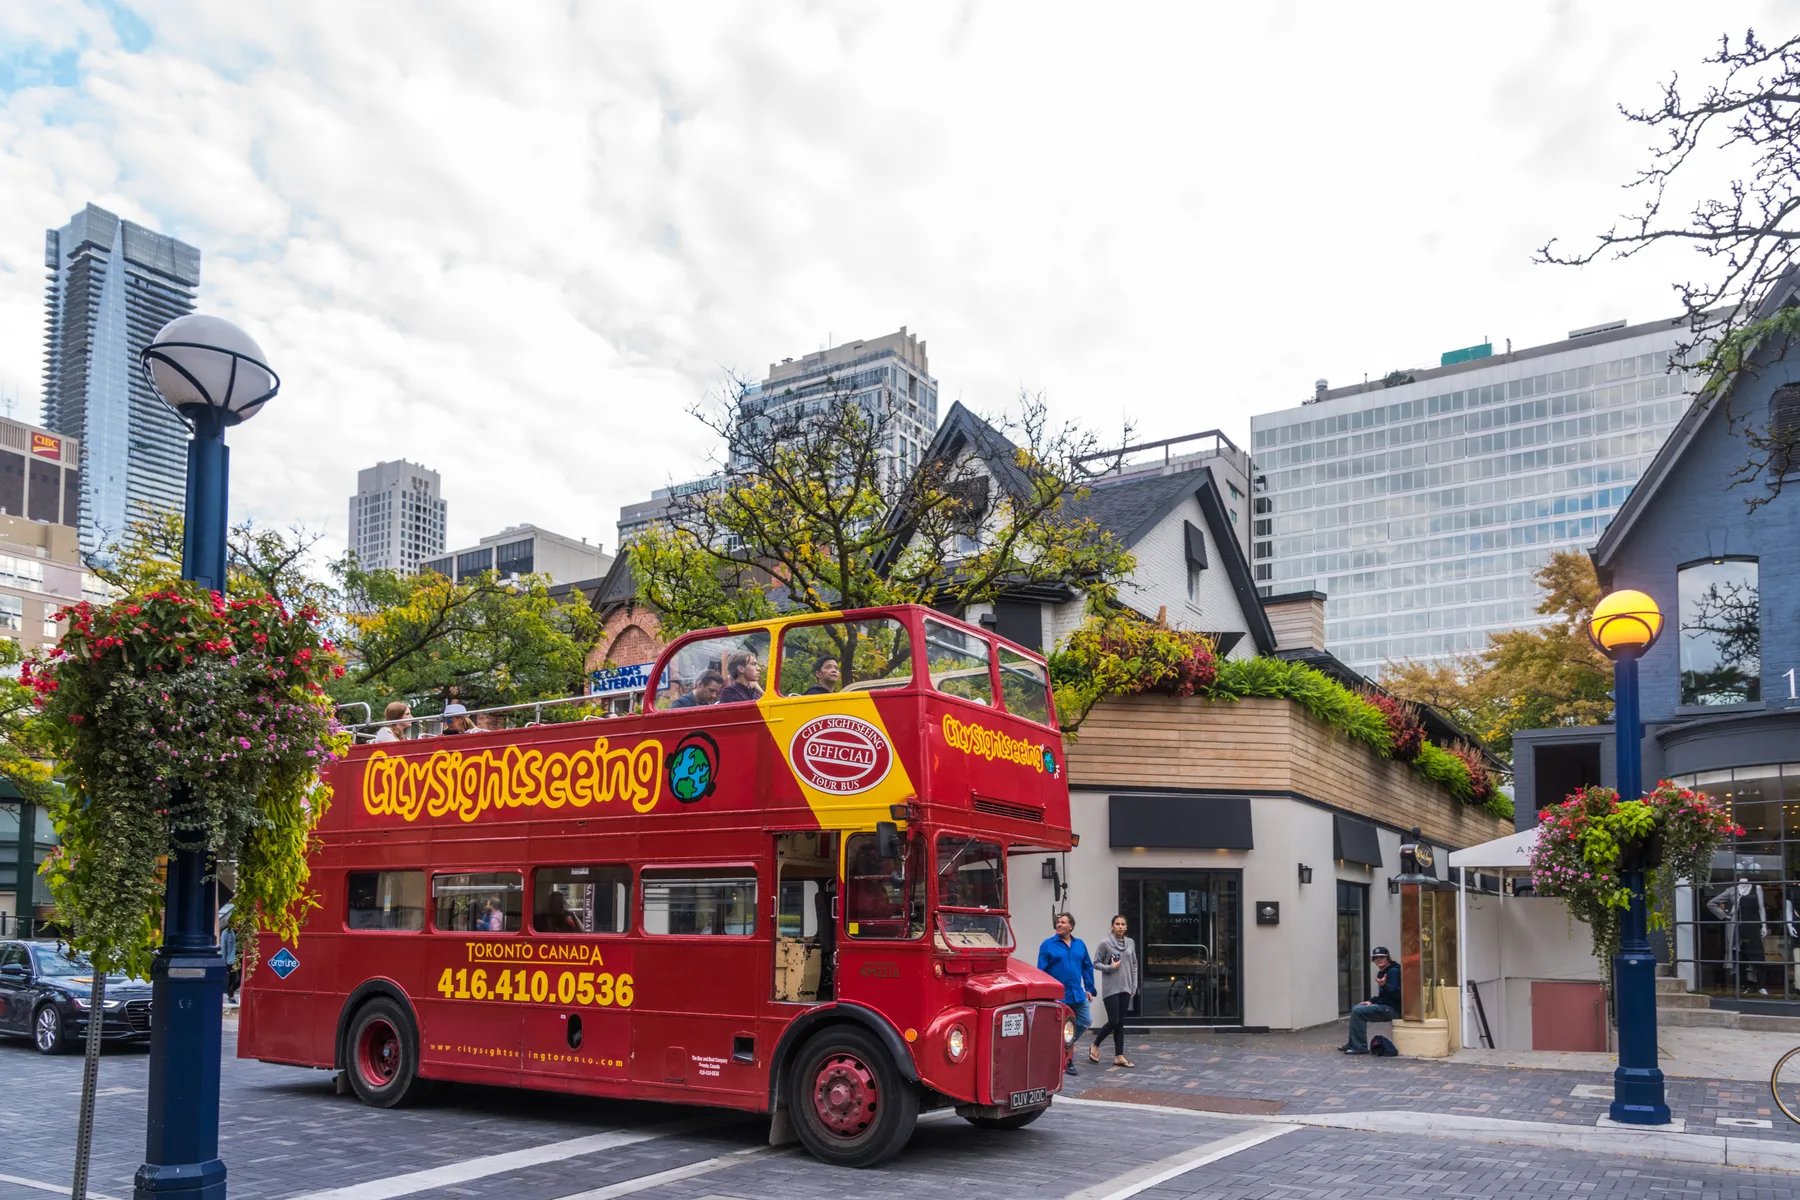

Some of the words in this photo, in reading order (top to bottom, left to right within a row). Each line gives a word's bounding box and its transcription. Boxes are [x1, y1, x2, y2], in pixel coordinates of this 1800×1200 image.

[34, 435, 59, 449] CIBC
[801, 720, 824, 739] CITY
[827, 718, 885, 750] SIGHTSEEING
[807, 743, 872, 764] OFFICIAL
[811, 773, 837, 790] TOUR
[841, 780, 860, 791] BUS
[466, 942, 533, 962] TORONTO
[538, 944, 604, 966] CANADA
[437, 967, 634, 1007] 416.410.0536
